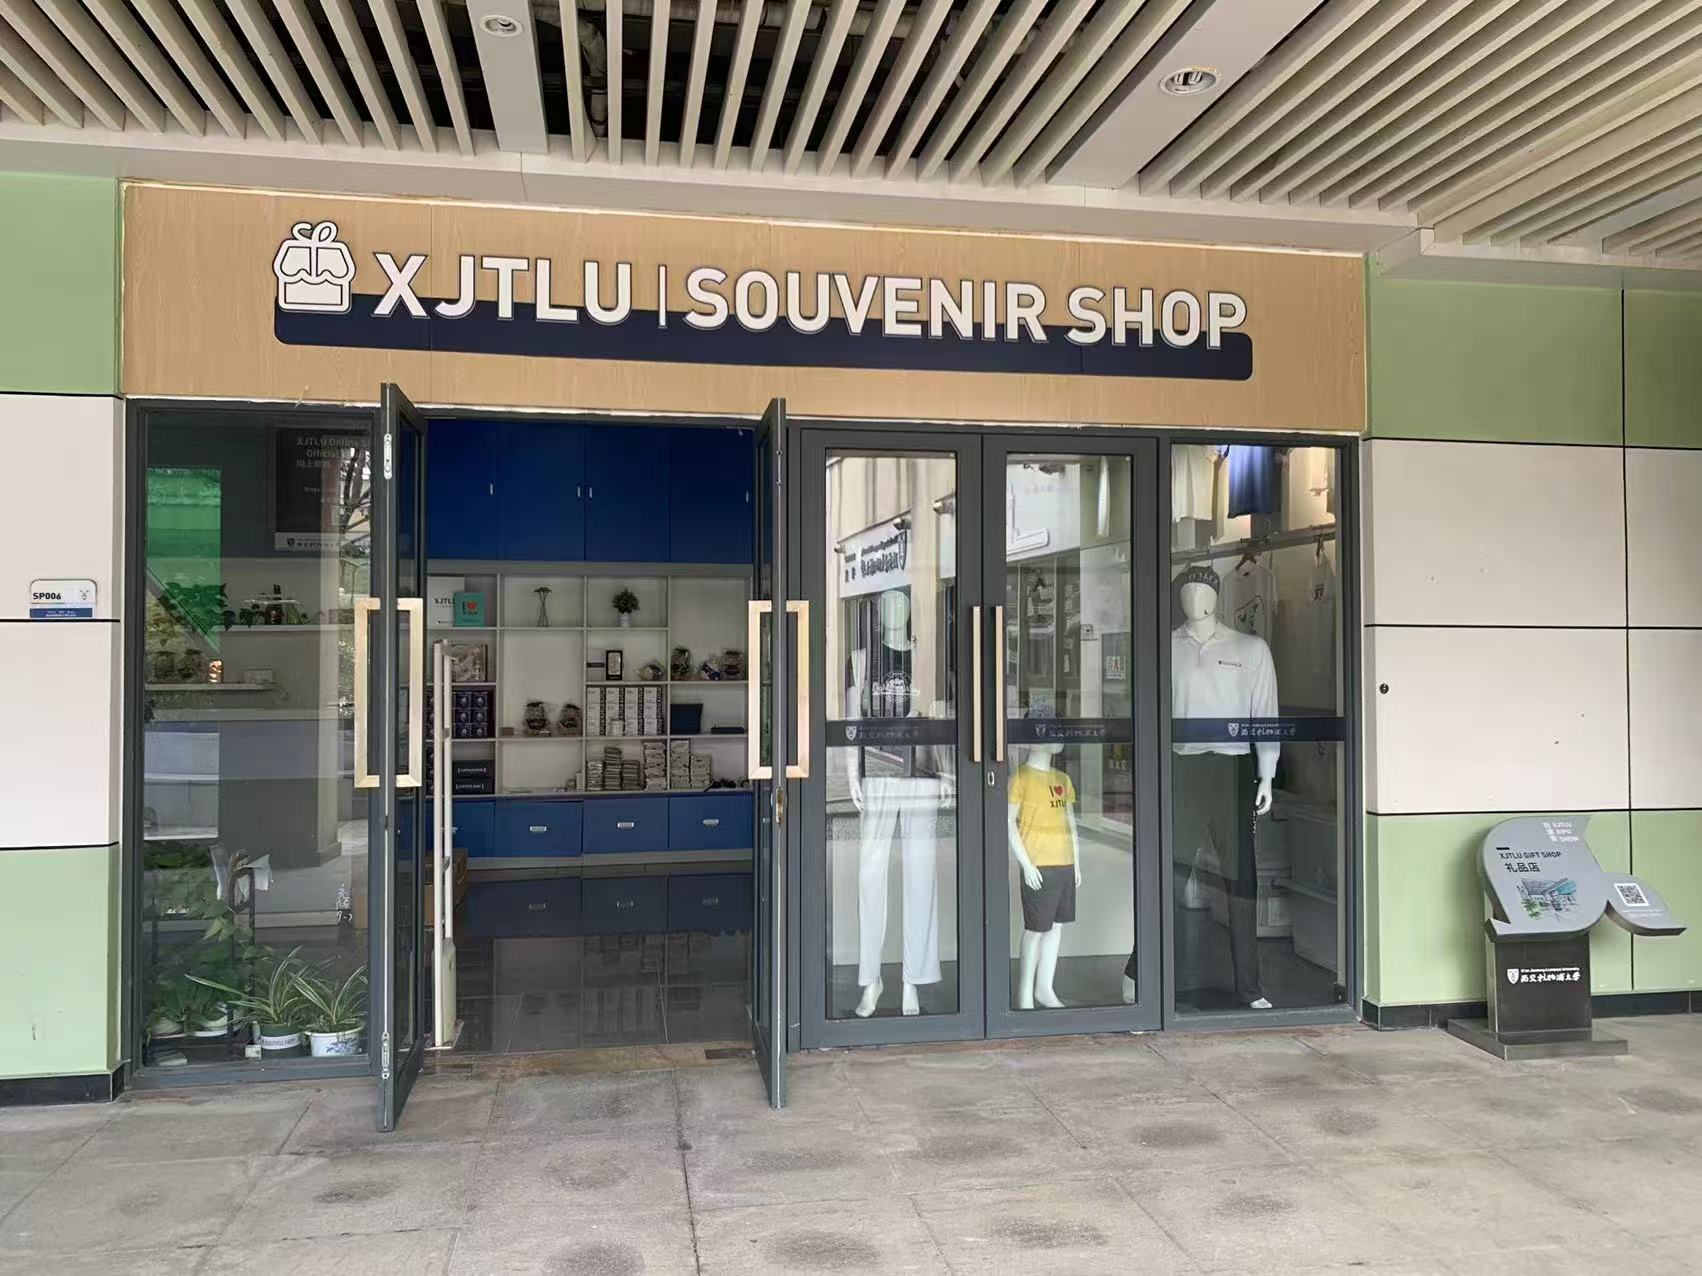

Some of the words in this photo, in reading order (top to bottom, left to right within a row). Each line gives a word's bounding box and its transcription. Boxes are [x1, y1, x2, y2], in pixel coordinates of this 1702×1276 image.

[372, 252, 632, 325] XJTLU
[683, 266, 1049, 342] SOUVENIR
[1064, 286, 1248, 349] SHOP
[33, 592, 62, 600] SP006
[1505, 862, 1540, 873] 礼品店
